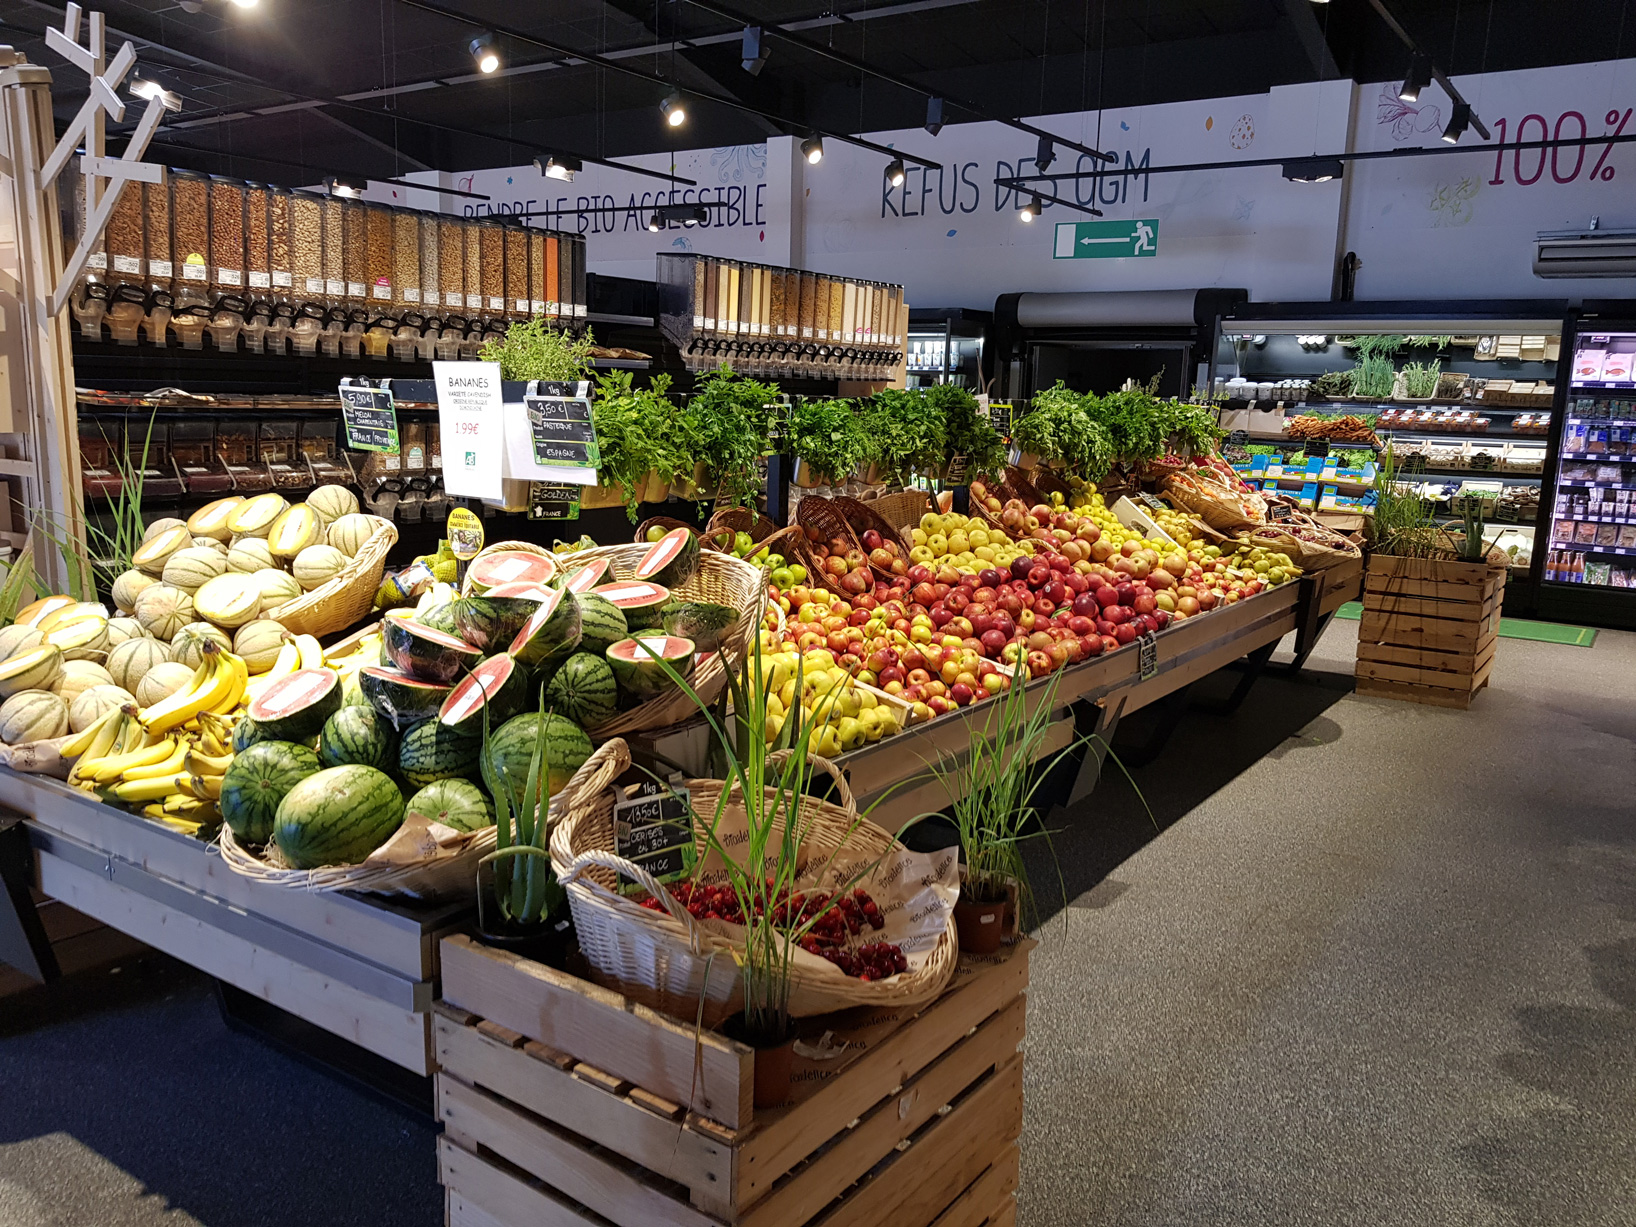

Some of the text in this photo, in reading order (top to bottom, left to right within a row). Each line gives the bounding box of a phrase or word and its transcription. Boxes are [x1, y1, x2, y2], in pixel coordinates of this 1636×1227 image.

[1489, 107, 1634, 186] 100%
[881, 147, 1151, 218] REFUS DES OGM
[577, 195, 616, 234] BIO
[624, 183, 768, 233] ACCESSIBLE
[448, 377, 489, 388] BANANES
[548, 385, 560, 396] 1kg
[354, 410, 372, 418] MELON
[537, 402, 556, 417] 3,50
[455, 422, 479, 434] 1.99€
[546, 448, 576, 458] ESPAGNE
[541, 490, 571, 500] GOLDEN
[643, 781, 656, 794] 1kg
[627, 803, 659, 823] 13,50€
[630, 826, 664, 844] CERISES
